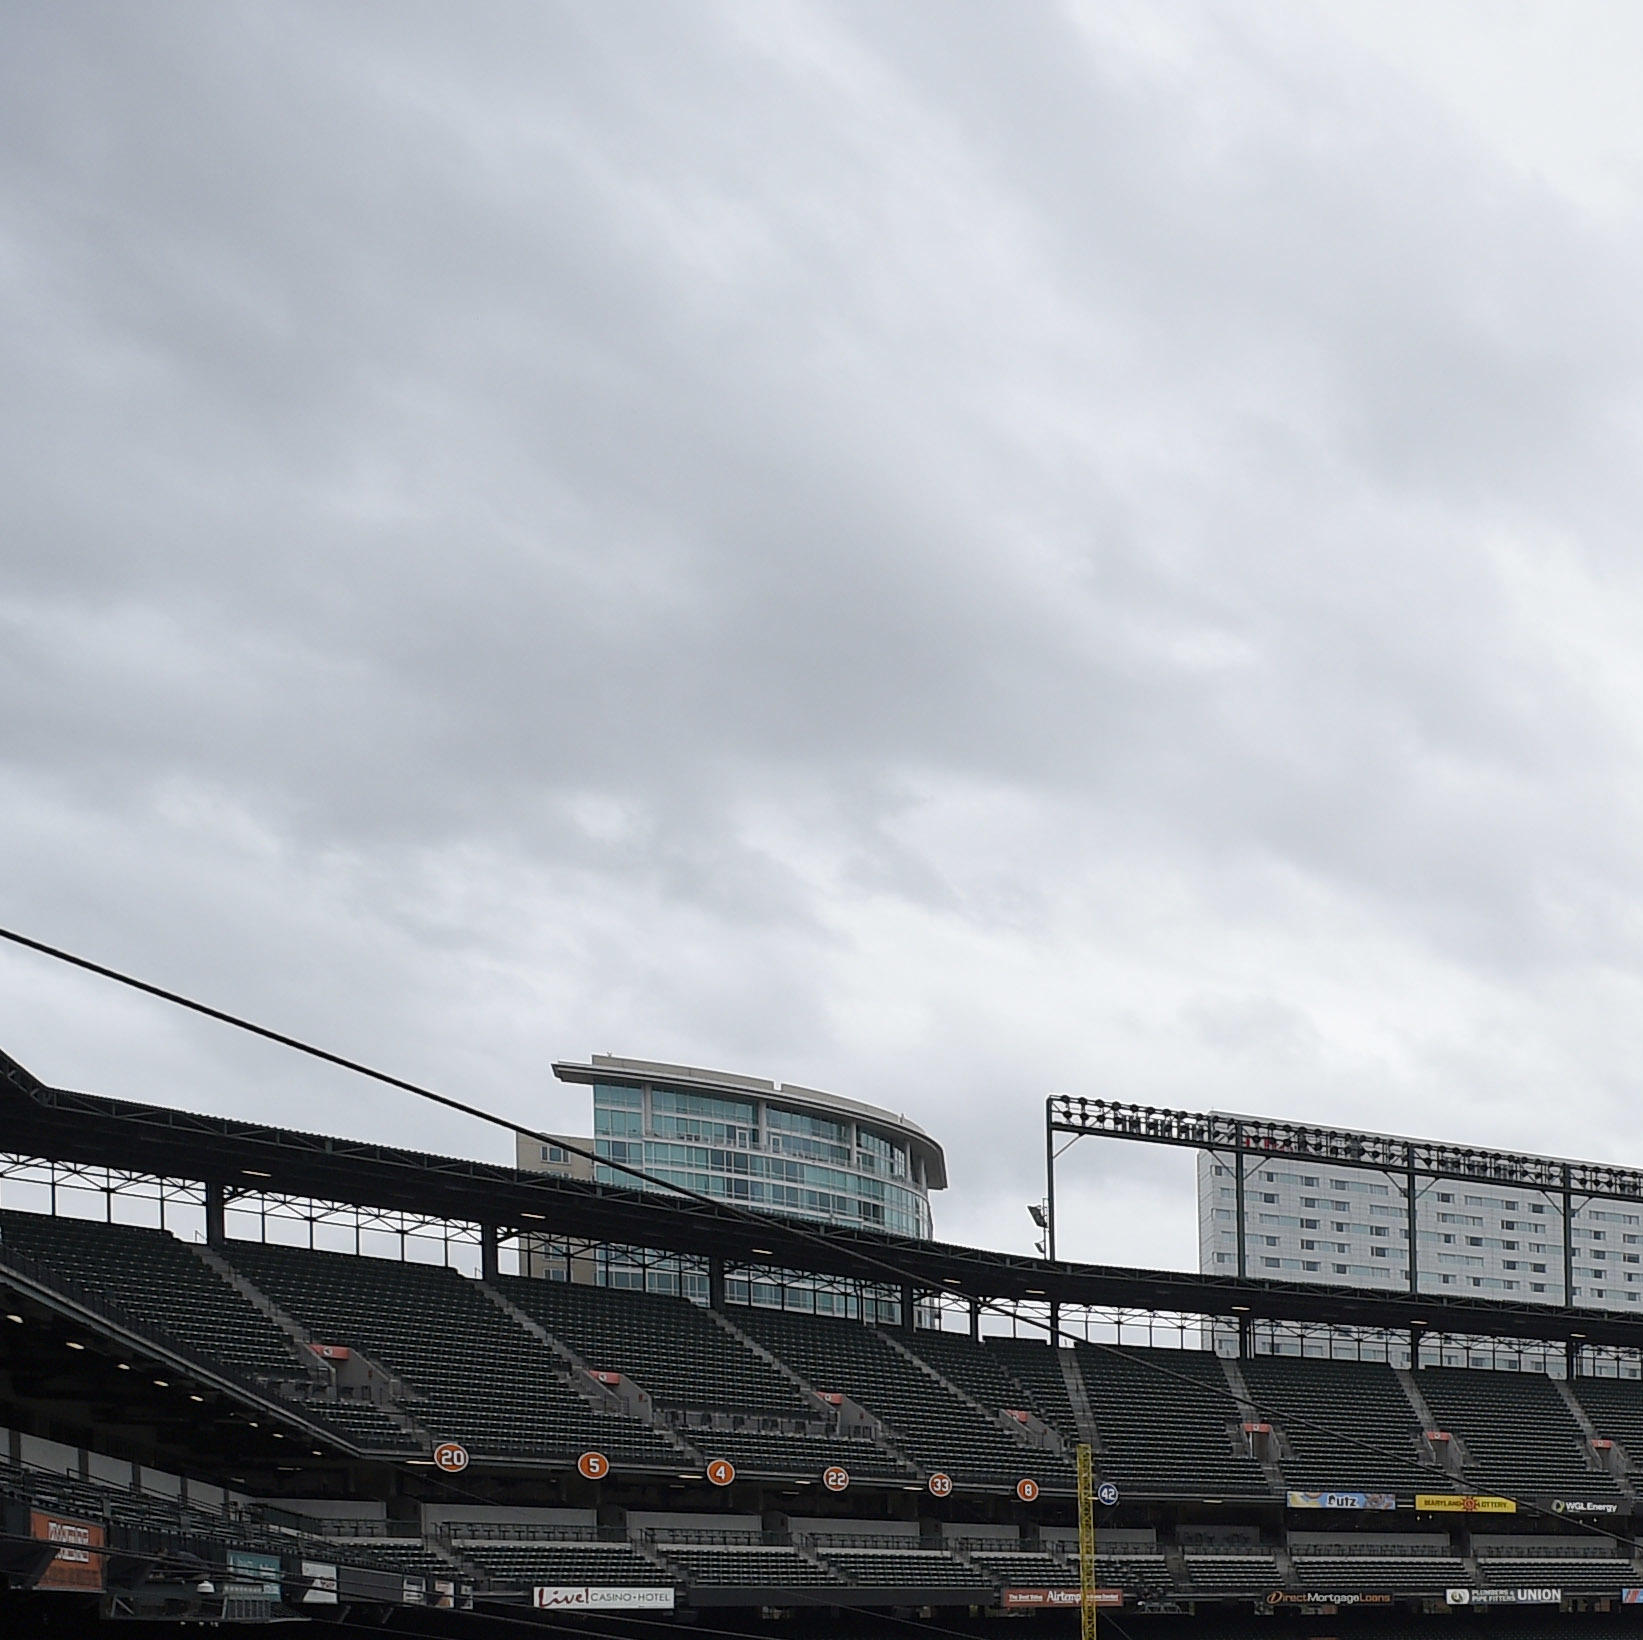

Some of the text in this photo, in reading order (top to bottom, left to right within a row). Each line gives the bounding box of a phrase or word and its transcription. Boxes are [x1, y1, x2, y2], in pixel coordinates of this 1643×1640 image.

[440, 1449, 465, 1466] 20
[588, 1457, 600, 1473] 5
[715, 1465, 726, 1480] 4
[828, 1471, 846, 1486] 22
[932, 1478, 949, 1491] 33
[1024, 1484, 1033, 1496] 8
[1100, 1488, 1115, 1500] 42
[1479, 1500, 1507, 1508] LOTTERY
[1566, 1502, 1618, 1513] WGL Energy
[538, 1587, 671, 1608] Live! CASINO HOTEL
[1046, 1590, 1082, 1604] Airtemp
[1517, 1588, 1561, 1601] UNION
